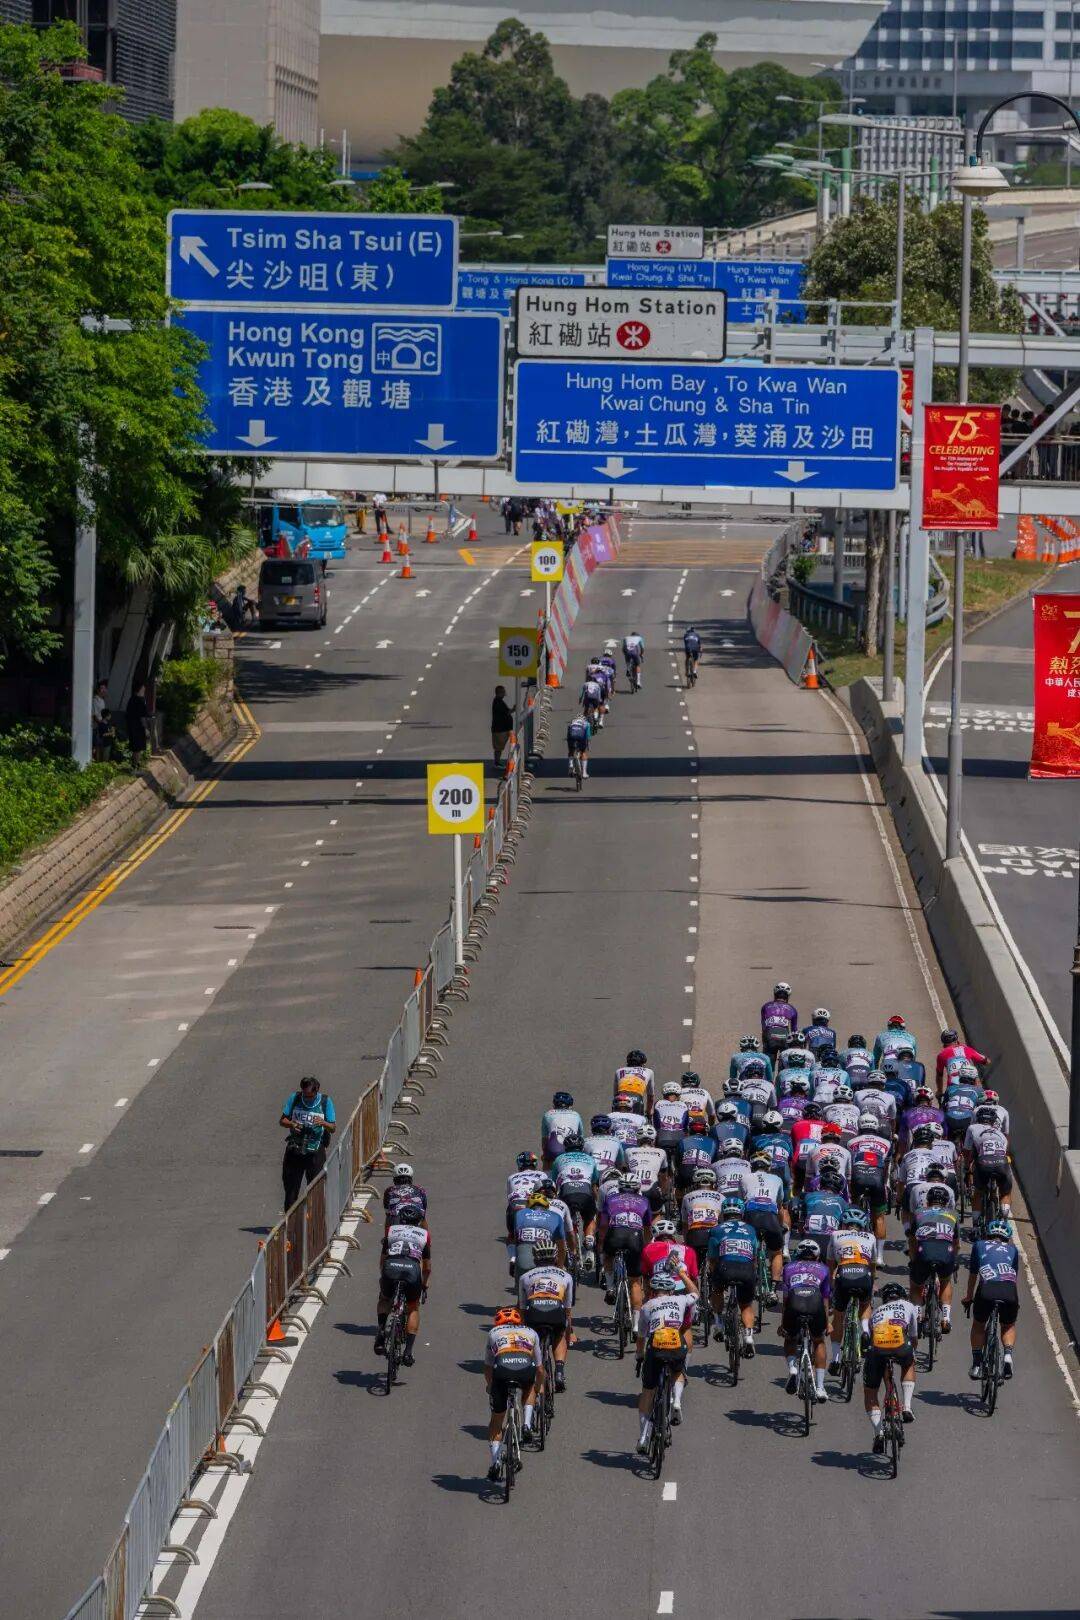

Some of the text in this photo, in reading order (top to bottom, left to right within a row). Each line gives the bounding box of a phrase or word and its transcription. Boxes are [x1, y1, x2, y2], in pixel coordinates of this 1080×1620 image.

[611, 228, 700, 239] Hung Hom Station
[227, 228, 442, 258] Tsim Sha Tsui (E)
[226, 259, 394, 292] 尖沙咀(東)
[627, 263, 697, 273] Hong Kong (W)
[727, 265, 795, 276] Hung Hom Bay
[467, 274, 489, 285] Tong
[557, 277, 574, 285] (C)
[678, 274, 694, 282] Sha
[697, 275, 711, 283] Tin
[734, 275, 744, 283] To
[770, 276, 789, 285] Wan
[526, 296, 716, 315] Hung Hom Station
[228, 321, 365, 349] Hong Kong
[529, 321, 611, 347] 紅磡站
[228, 346, 364, 374] Kwun Tong
[377, 350, 390, 366] 中
[423, 351, 436, 366] C
[566, 372, 613, 393] Hung
[621, 373, 663, 390] Hom
[725, 375, 748, 392] To
[758, 376, 797, 393] Kwa
[807, 377, 847, 394] Wan
[228, 376, 411, 409] 香港及觀塘
[601, 395, 810, 416] Kwai Chung & Sha Tin
[943, 411, 981, 445] 75
[929, 446, 995, 455] CELEBRATING
[538, 555, 556, 565] 100
[507, 645, 529, 657] 150
[439, 788, 473, 805] 200
[452, 809, 461, 818] m
[669, 1311, 680, 1320] 45
[893, 1310, 905, 1319] 53
